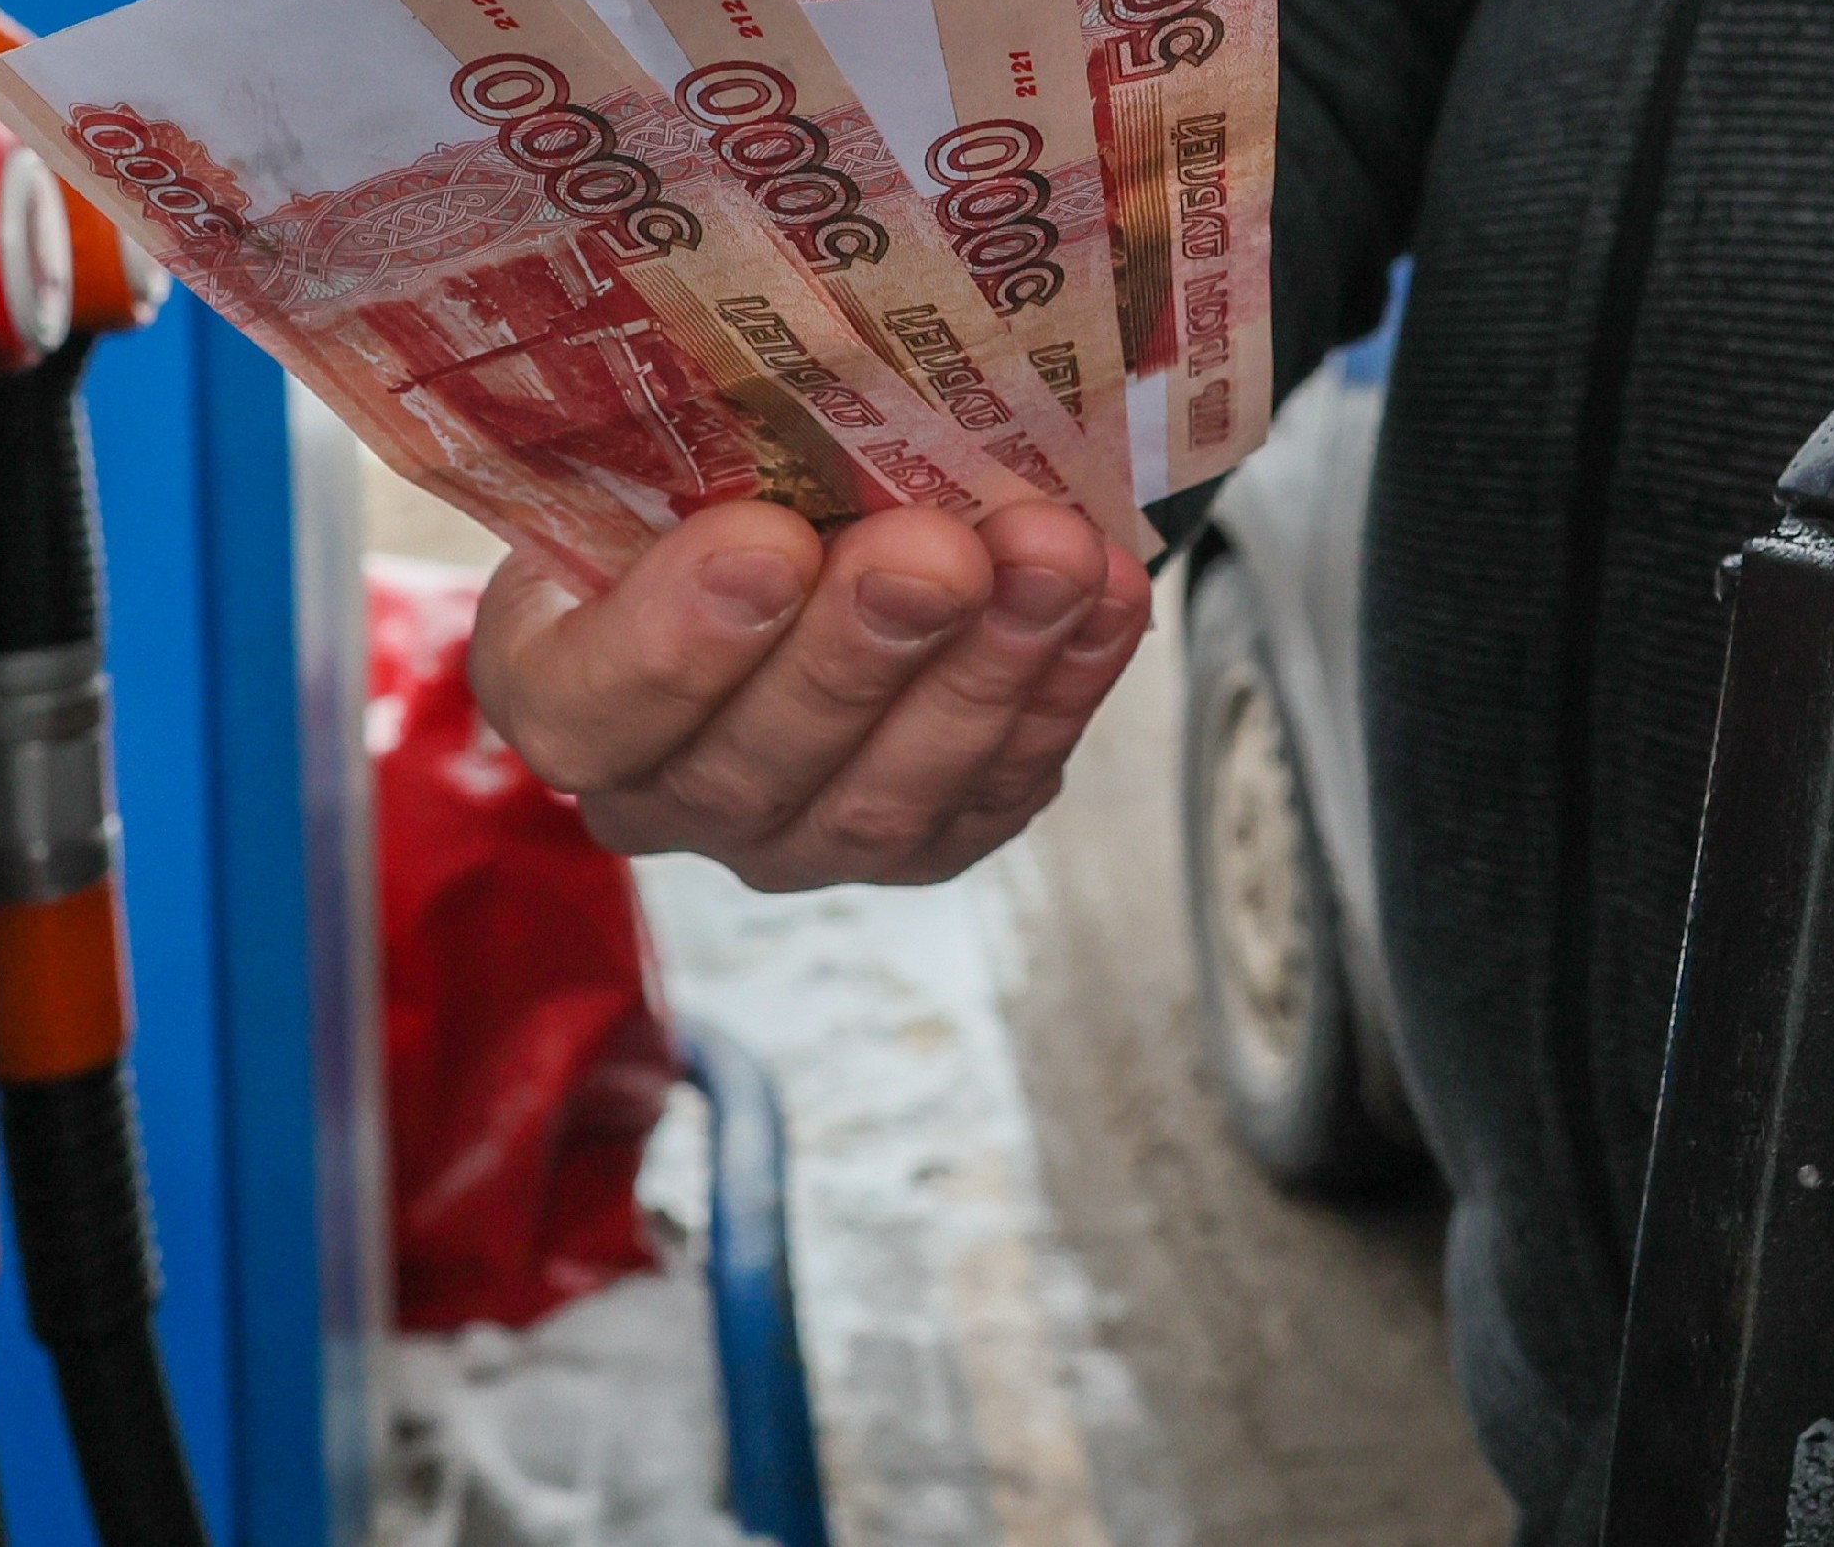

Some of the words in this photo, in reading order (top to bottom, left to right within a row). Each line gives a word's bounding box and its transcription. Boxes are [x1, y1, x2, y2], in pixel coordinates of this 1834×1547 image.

[1008, 50, 1037, 98] 2121
[79, 112, 247, 241] 5000
[449, 53, 703, 267] 5000
[674, 60, 890, 274] 5000
[924, 118, 1065, 319] 5000
[1170, 111, 1230, 260] ДУБЛЕЙ
[714, 295, 888, 428] ДУБЛЕЙ
[880, 303, 1015, 432] ДУБЛЕЙ
[1184, 269, 1230, 378] ТЫСЯЧ
